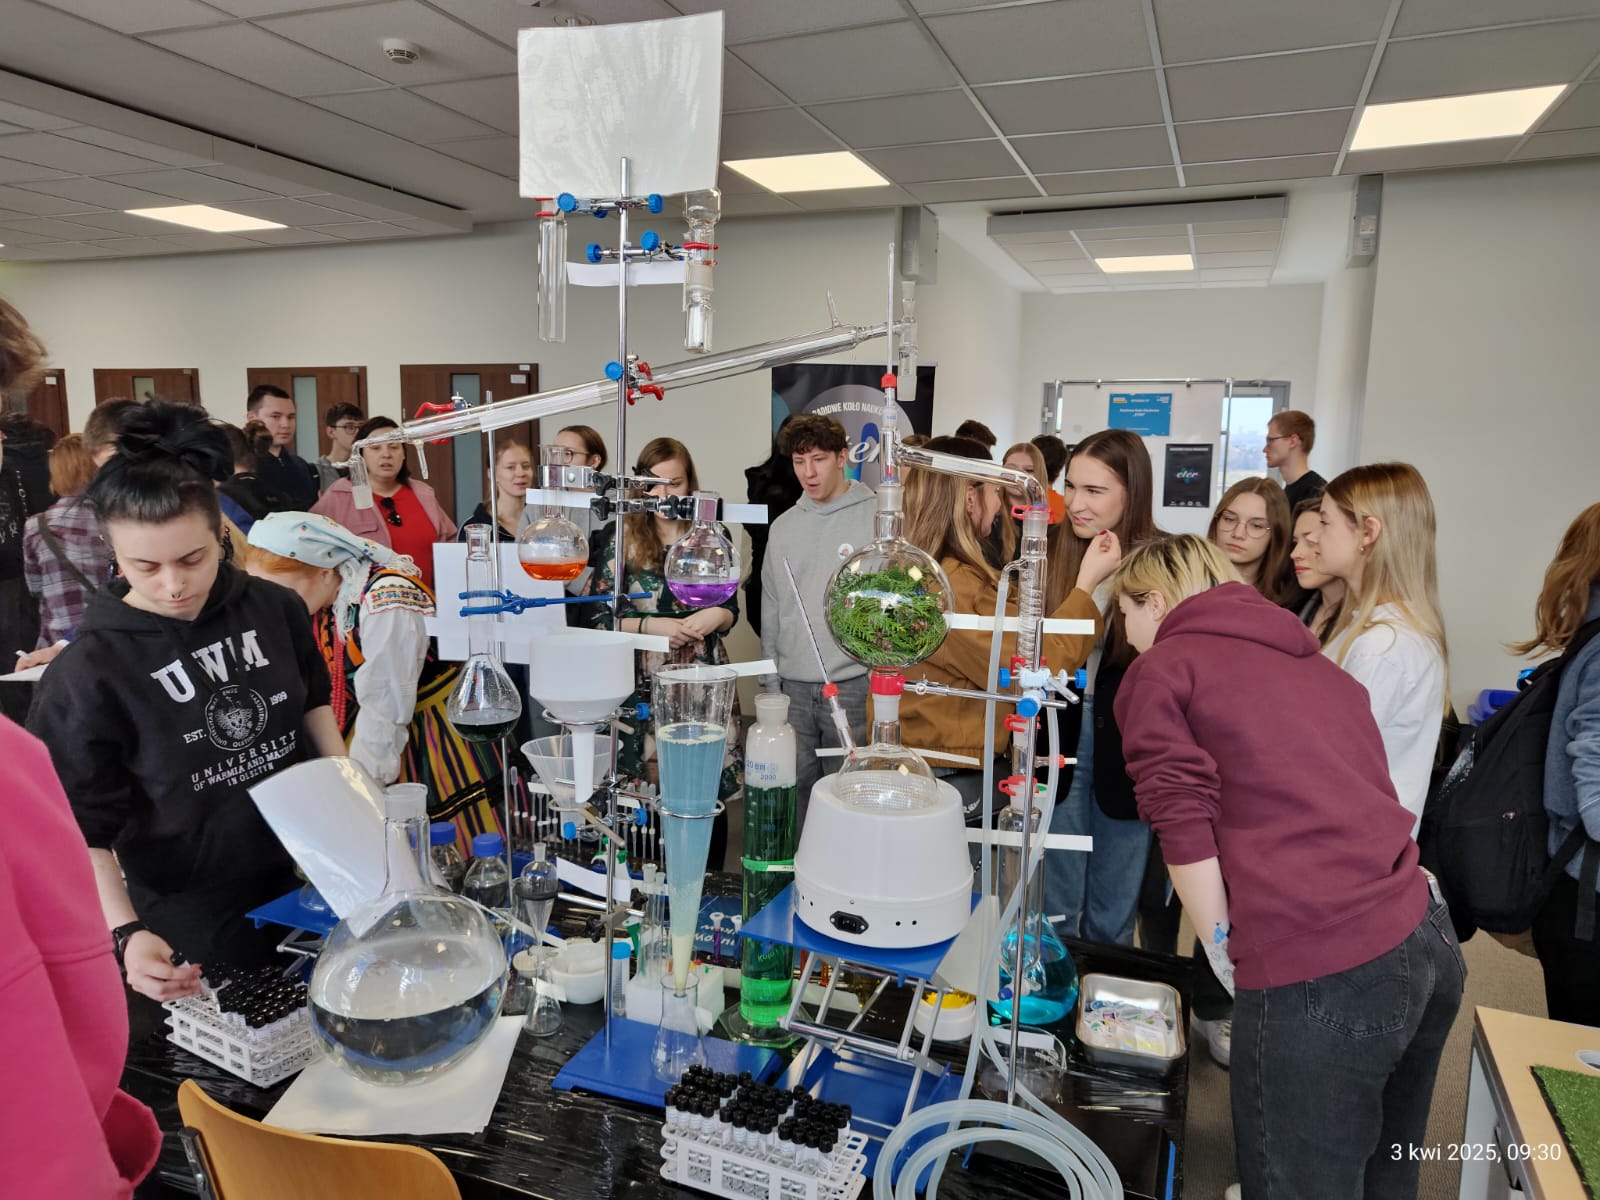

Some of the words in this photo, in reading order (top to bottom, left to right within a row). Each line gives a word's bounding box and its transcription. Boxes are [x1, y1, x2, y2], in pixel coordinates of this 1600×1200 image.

[183, 729, 207, 744] EST.
[191, 730, 297, 784] UNIVERSITY
[193, 780, 206, 792] OF
[208, 764, 246, 786] WARMIA
[247, 755, 265, 770] AND
[227, 775, 238, 787] IN
[239, 762, 275, 783] OLSZTYN
